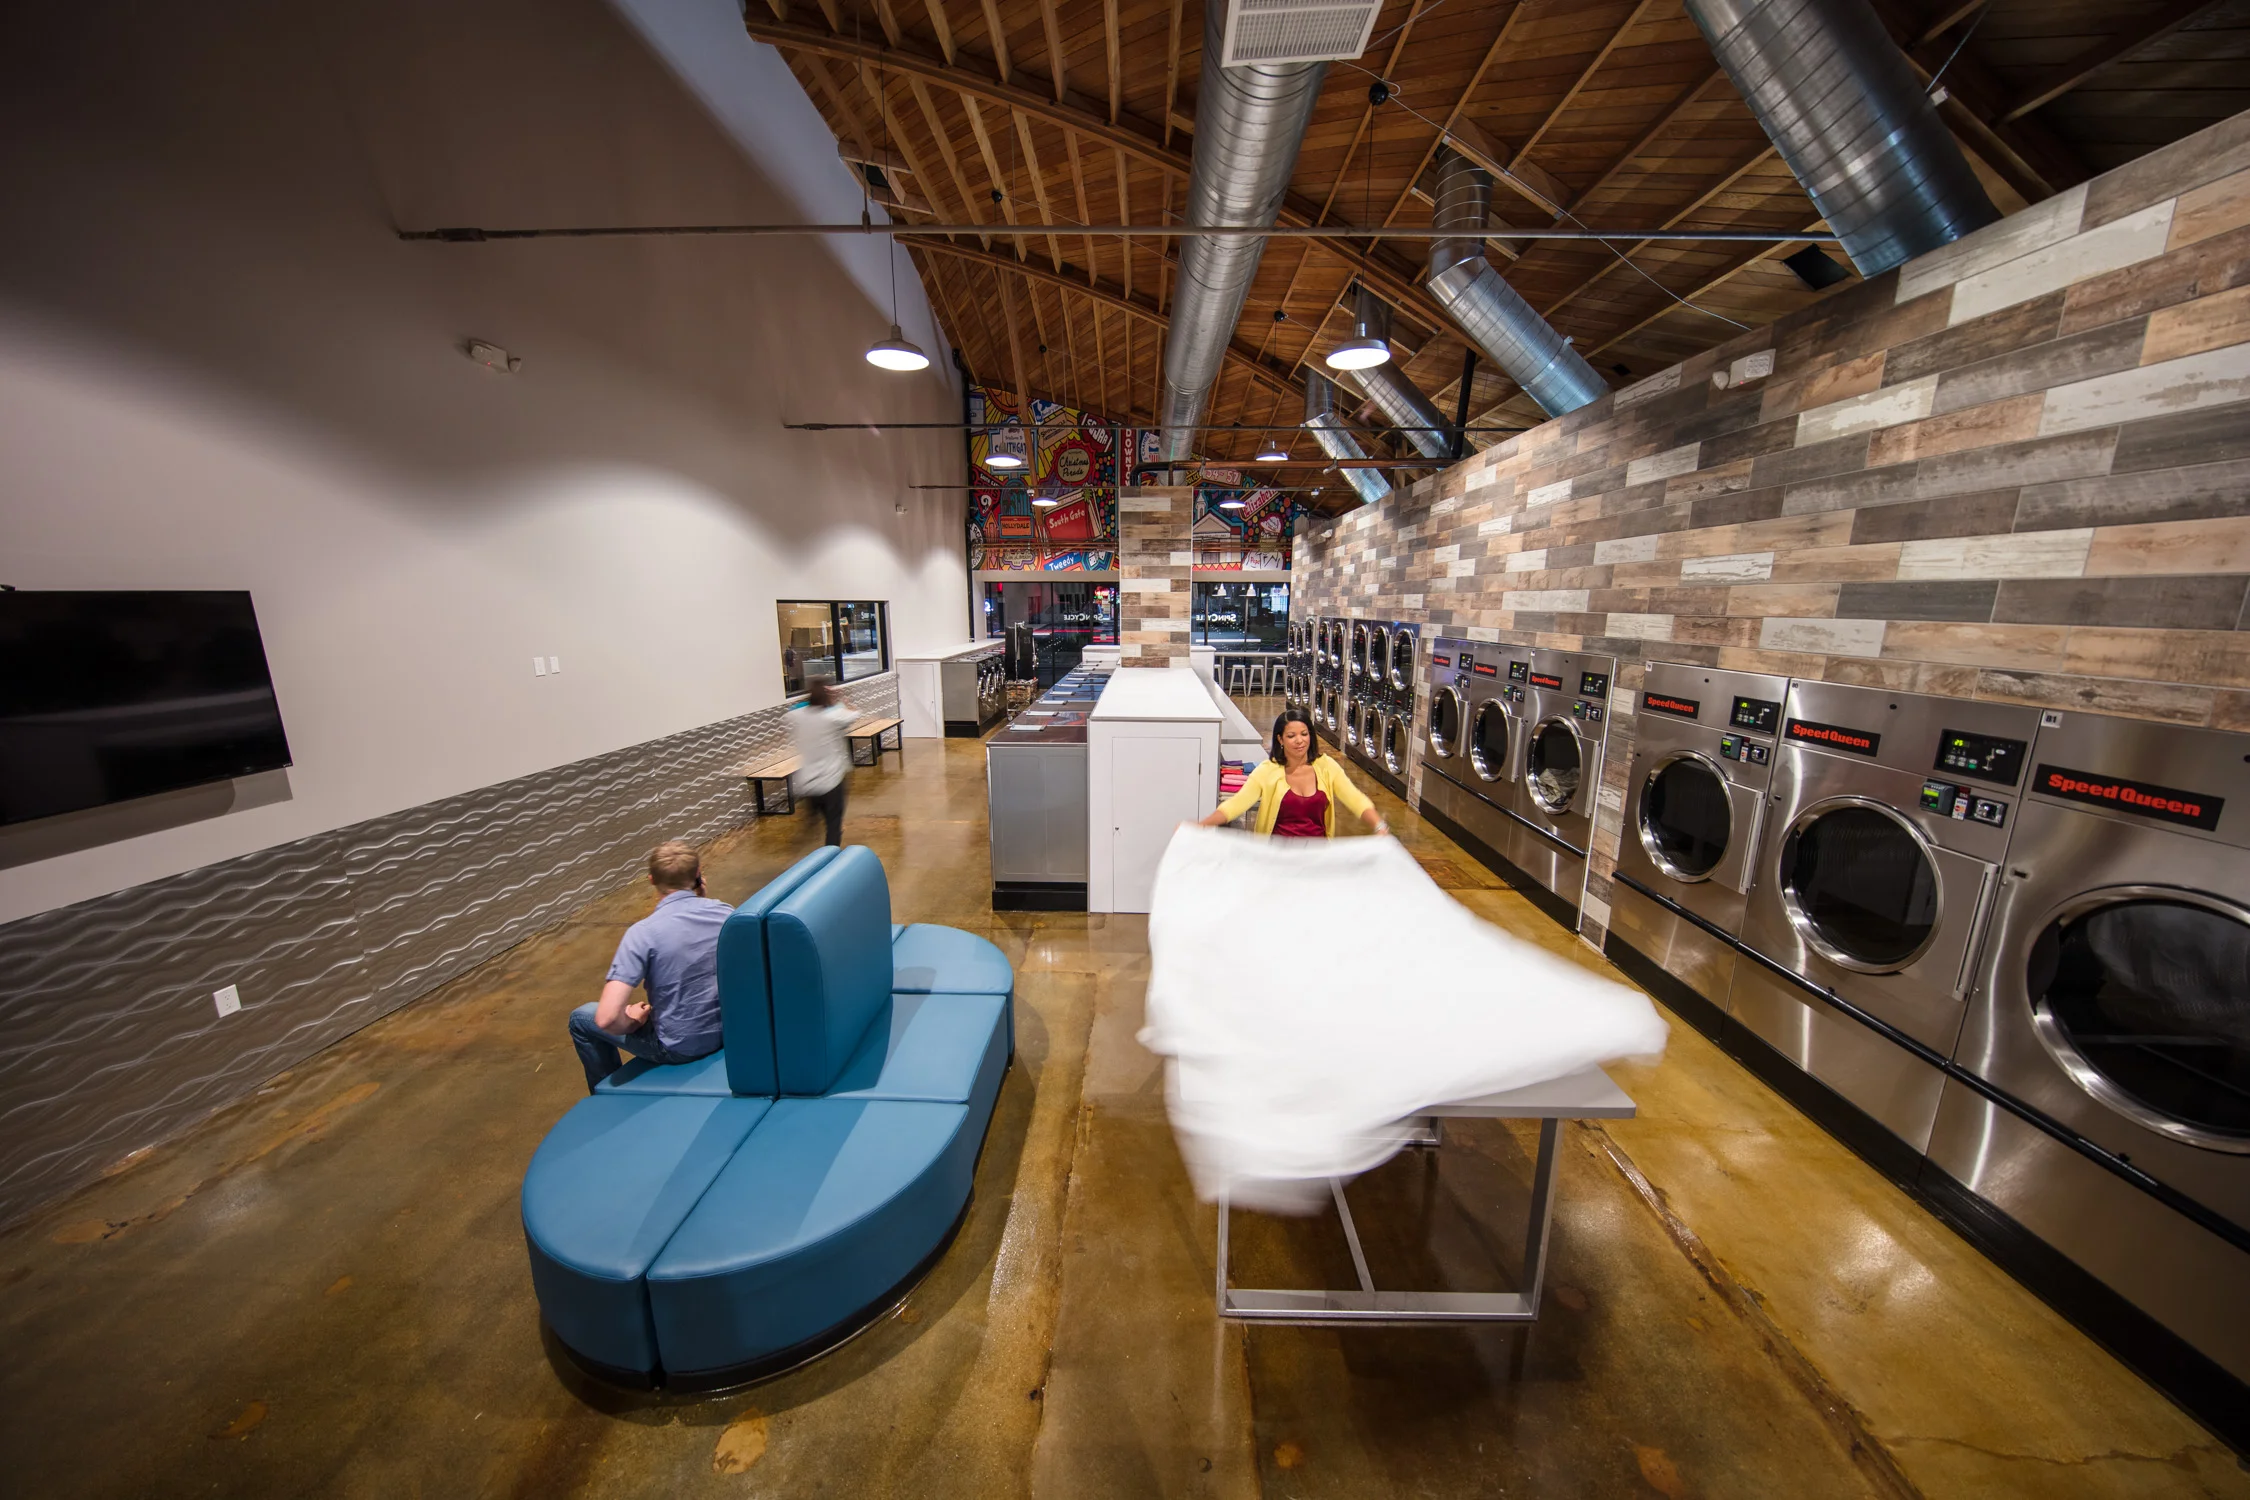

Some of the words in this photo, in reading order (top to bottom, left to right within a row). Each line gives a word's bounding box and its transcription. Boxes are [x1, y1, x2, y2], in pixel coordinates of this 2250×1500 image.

[1060, 456, 1089, 467] Christmas
[1049, 512, 1069, 529] South
[1069, 509, 1085, 521] Gate
[1049, 555, 1074, 571] Tweedy
[1647, 696, 1670, 707] Speed
[1669, 700, 1694, 713] Queen
[1793, 724, 1830, 740] Speed
[1829, 730, 1871, 749] Queen
[2048, 773, 2120, 800] Speed
[2119, 787, 2201, 818] Queen
